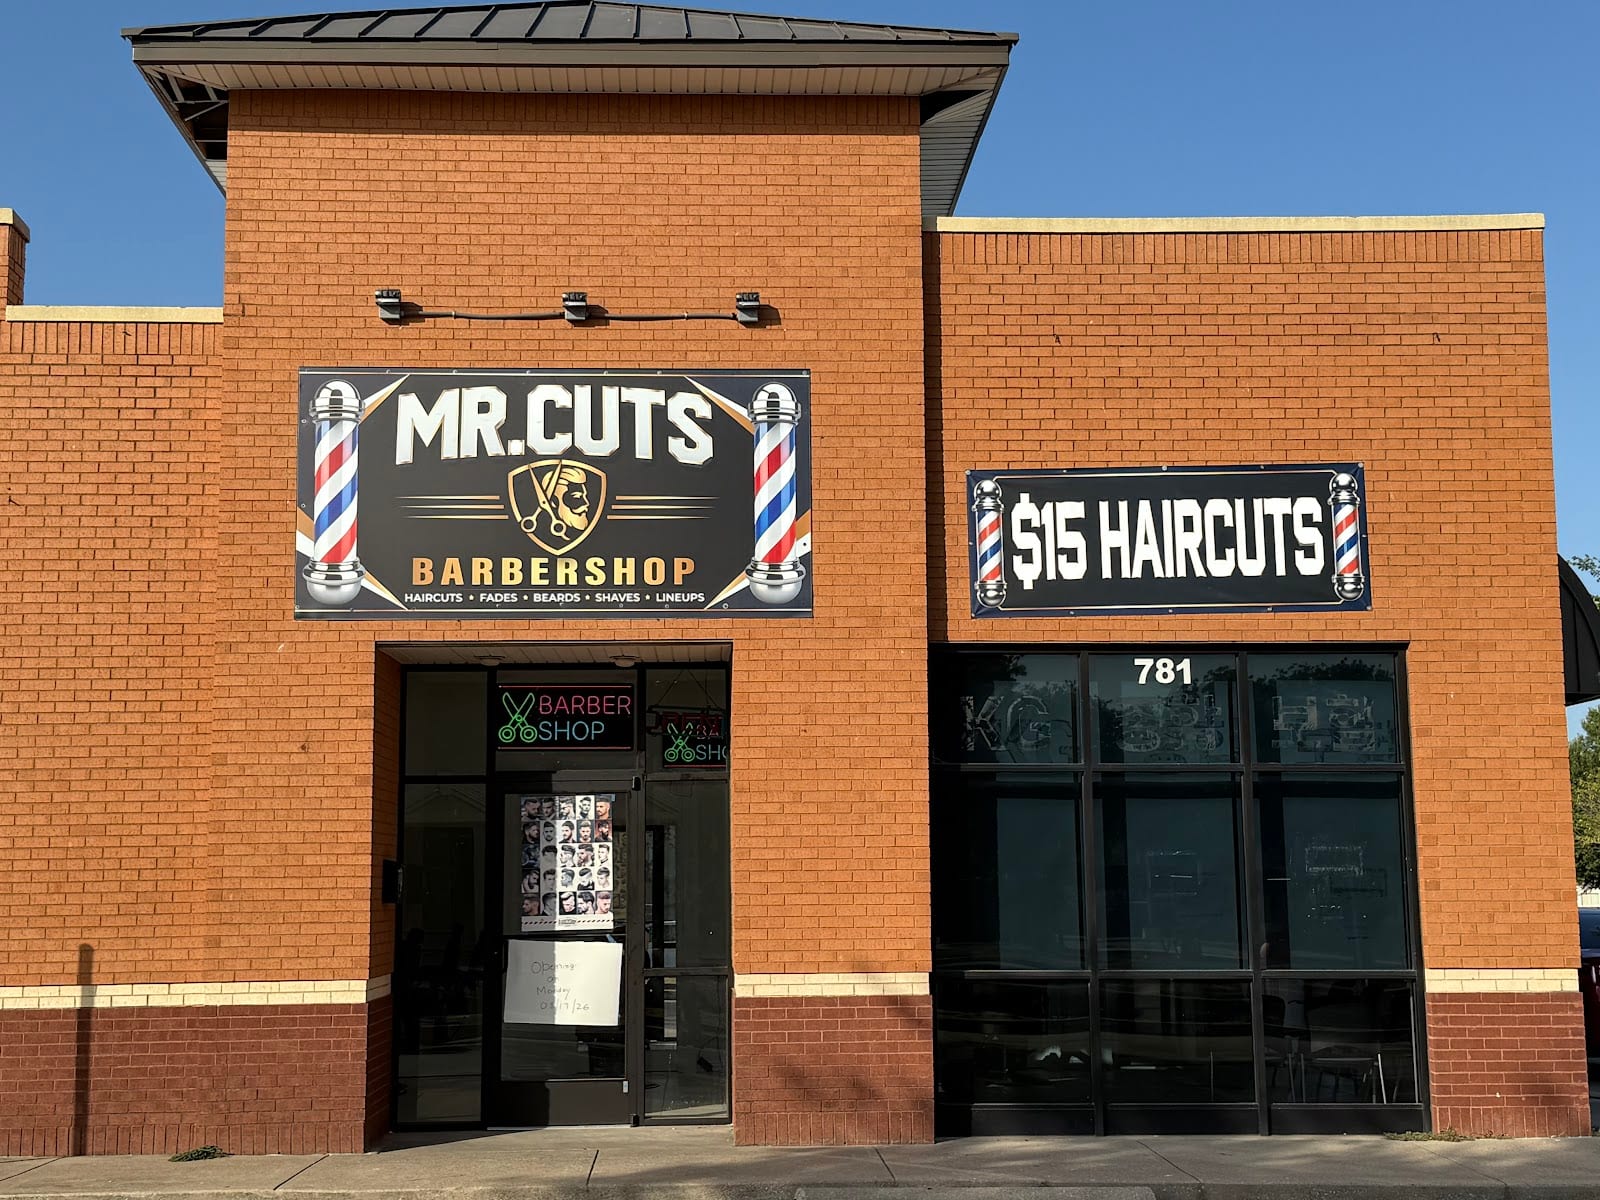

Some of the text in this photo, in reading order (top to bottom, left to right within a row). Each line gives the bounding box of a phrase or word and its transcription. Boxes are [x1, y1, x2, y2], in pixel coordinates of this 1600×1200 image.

[1010, 493, 1325, 590] $15 HAIRCUTS
[411, 556, 697, 587] BARBERSHOP
[404, 592, 706, 604] HAIRCUTS FADES BEARDS SHAVES LINEUPS
[1134, 657, 1193, 685] 781
[538, 695, 632, 715] BARBER
[538, 720, 605, 742] SHOP
